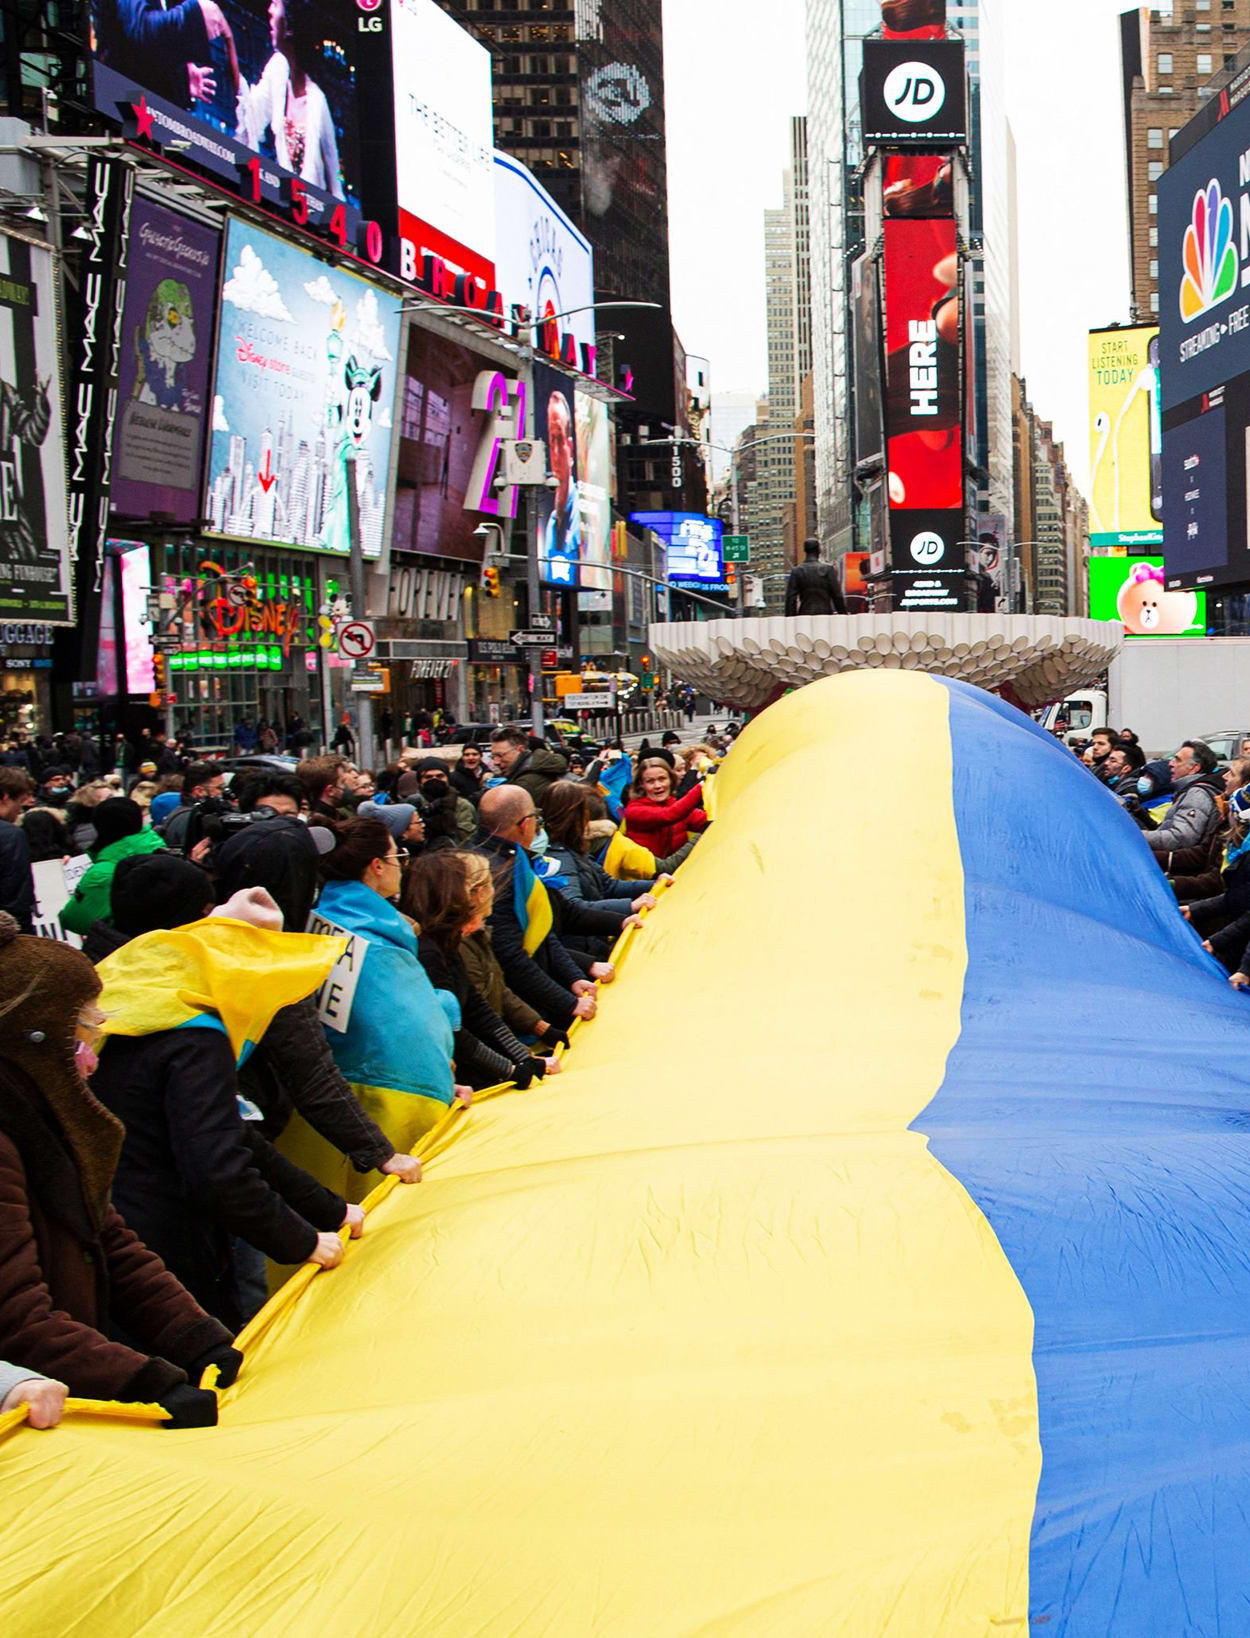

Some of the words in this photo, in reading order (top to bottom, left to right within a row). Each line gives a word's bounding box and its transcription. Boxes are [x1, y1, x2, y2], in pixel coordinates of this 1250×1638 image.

[357, 17, 383, 32] LG
[895, 78, 934, 106] JD
[1179, 322, 1221, 363] STREAMING
[1228, 304, 1250, 336] FREE
[1101, 340, 1128, 355] START
[908, 319, 938, 416] HERE
[1092, 353, 1138, 370] LISTENING
[1097, 367, 1134, 386] TODAY
[672, 446, 682, 488] 1500
[917, 541, 939, 555] JD
[536, 634, 551, 642] WAY
[6, 659, 31, 668] SONY
